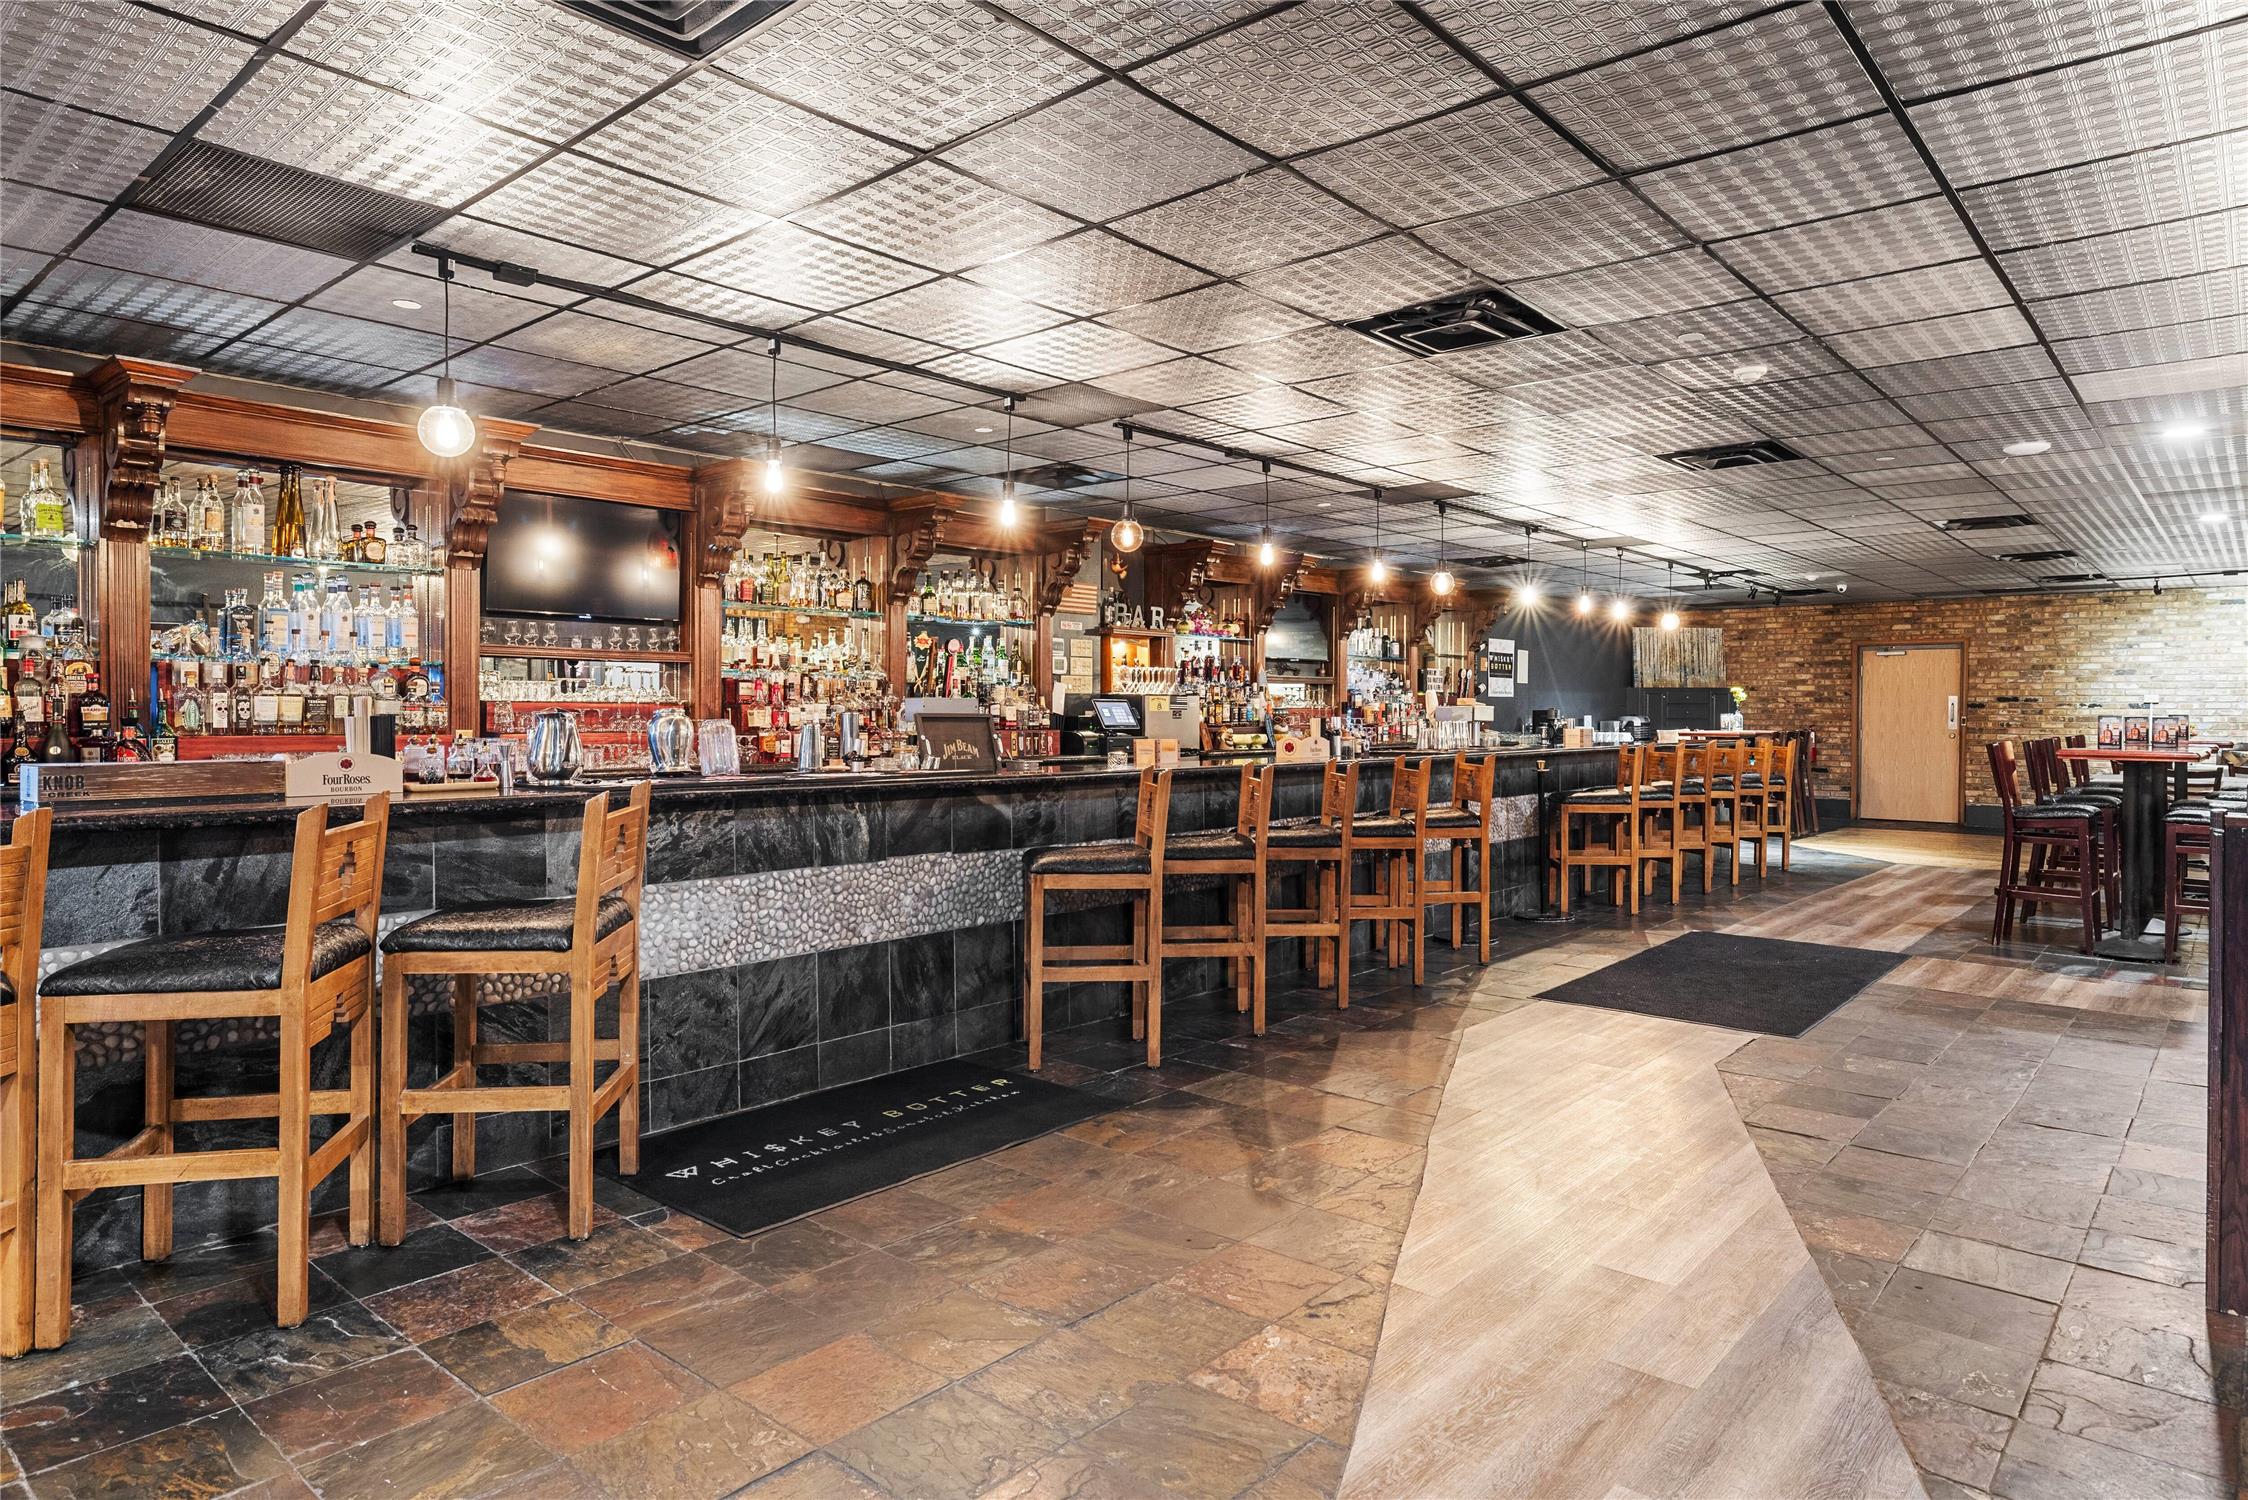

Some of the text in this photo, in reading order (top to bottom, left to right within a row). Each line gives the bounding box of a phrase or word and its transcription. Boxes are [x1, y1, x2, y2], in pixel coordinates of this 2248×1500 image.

[1113, 602, 1165, 630] BAR
[942, 739, 980, 760] JIM BEAM
[43, 775, 85, 791] KNOB
[711, 1165, 774, 1186] Craft
